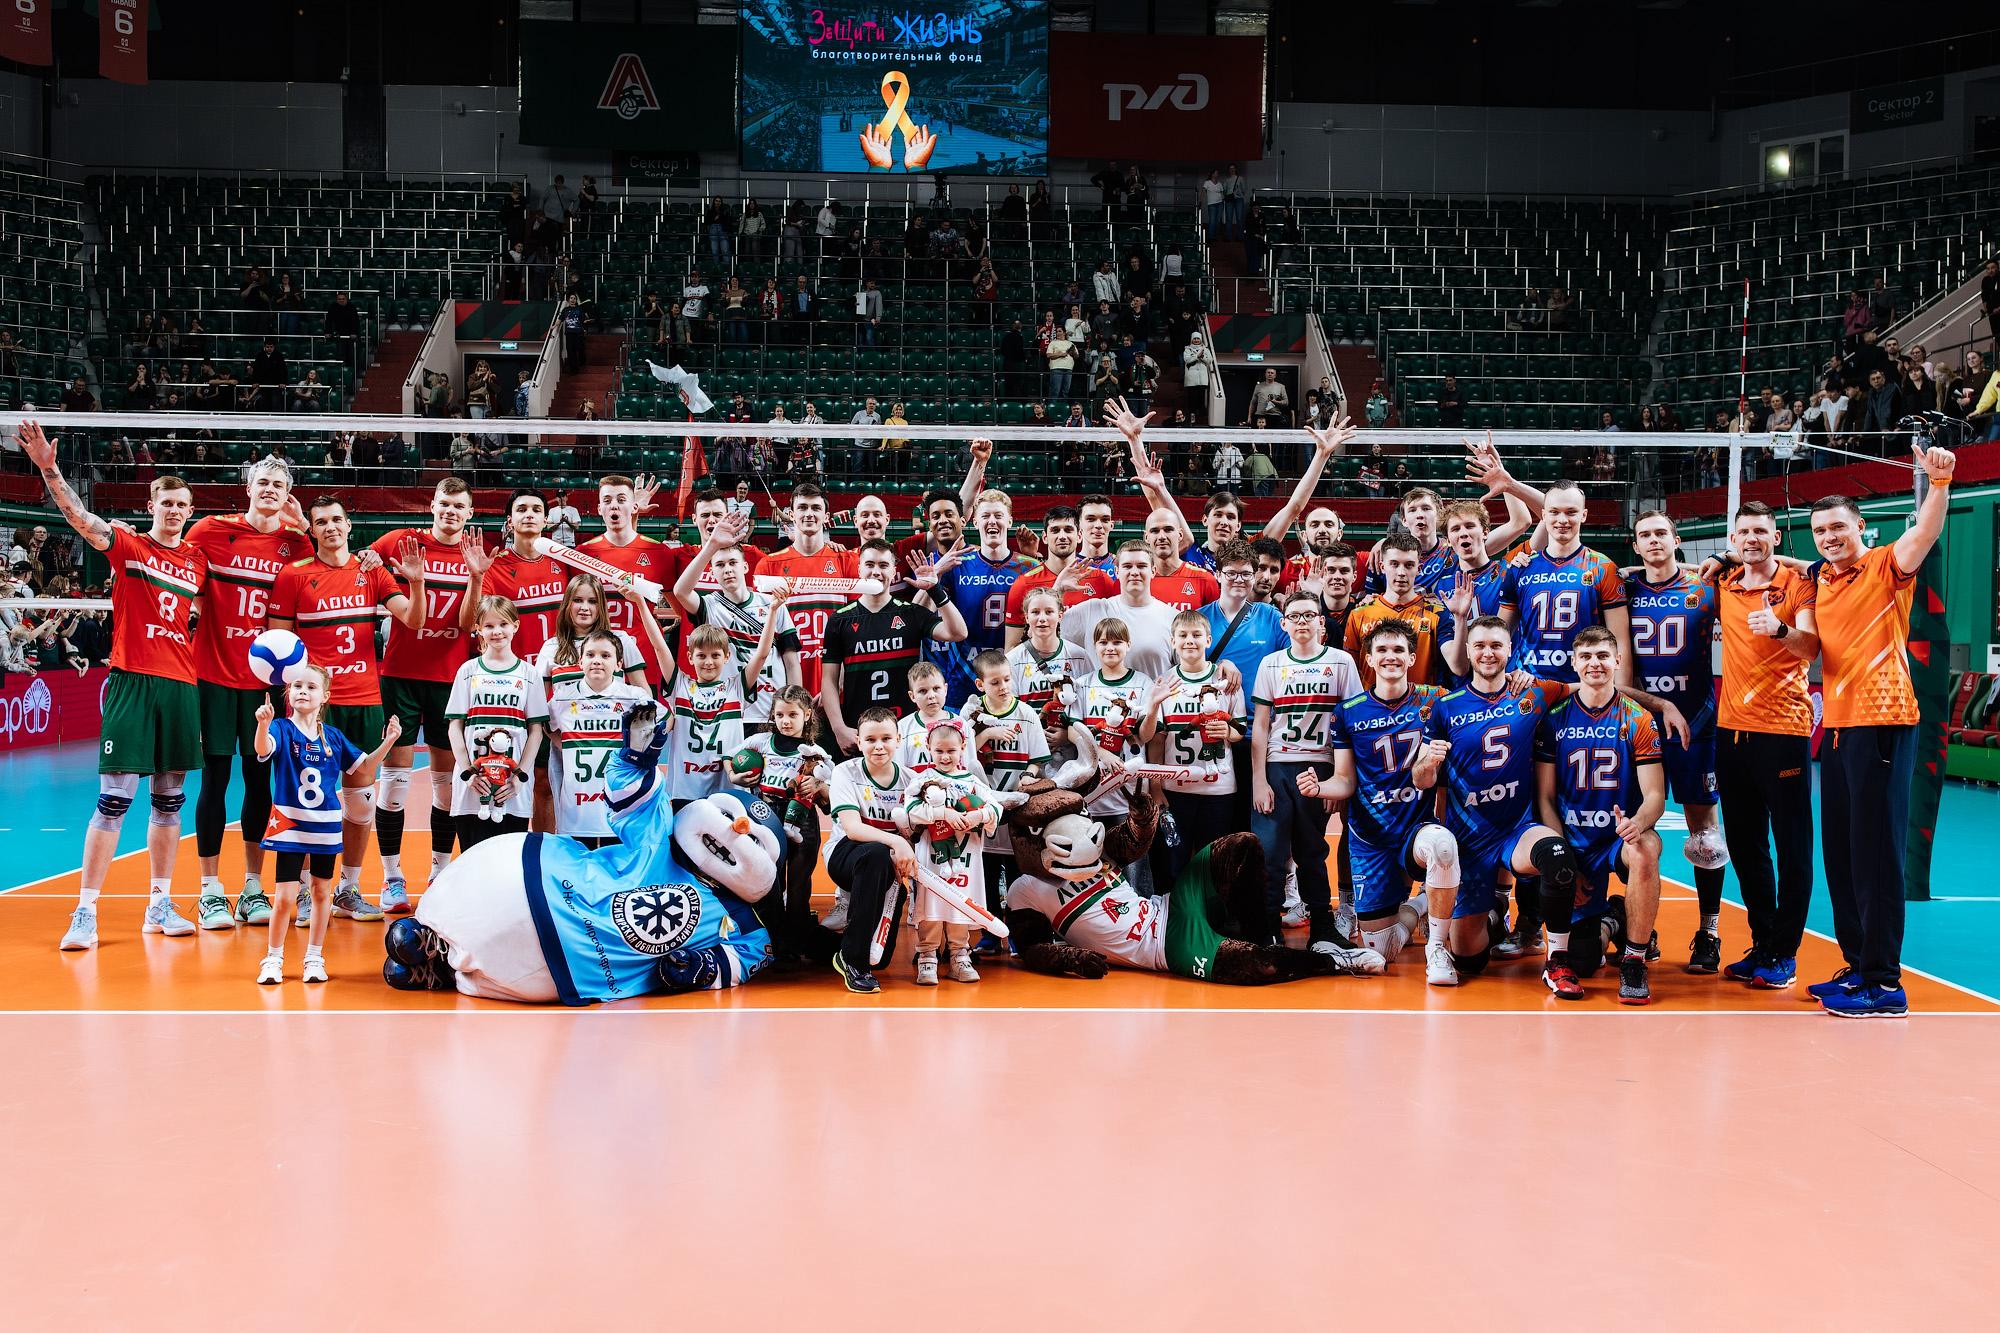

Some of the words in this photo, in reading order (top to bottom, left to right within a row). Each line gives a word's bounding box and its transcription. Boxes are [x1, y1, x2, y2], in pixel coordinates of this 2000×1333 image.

[114, 8, 134, 35] 6
[812, 49, 942, 62] благотворительный
[949, 52, 982, 63] фонд
[1868, 95, 1921, 113] Сектор
[1925, 90, 1935, 104] 2
[630, 156, 679, 172] Сектор
[959, 574, 1015, 587] КУЗБАСС
[1518, 572, 1577, 587] КУЗБАСС
[158, 591, 178, 623] 8
[237, 587, 269, 619] 16
[426, 590, 458, 619] 17
[608, 601, 634, 629] 21
[984, 593, 1007, 629] 8
[1532, 590, 1580, 630] 18
[538, 613, 548, 641] 1
[794, 611, 829, 639] 20
[1631, 616, 1687, 656] 20
[335, 626, 355, 654] 3
[870, 670, 890, 701] 2
[1282, 713, 1324, 745] 54
[1354, 712, 1415, 731] КУЗБАСС
[1450, 704, 1515, 727] КУЗБАСС
[104, 740, 113, 754] 8
[688, 720, 722, 755] 54
[1482, 724, 1511, 770] 5
[1555, 726, 1616, 742] КУЗБАСС
[305, 754, 319, 762] CUB
[1374, 728, 1423, 773] 17
[1568, 747, 1619, 790] 12
[298, 767, 324, 809] 8
[1464, 780, 1519, 808] АЗОТ
[635, 941, 670, 954] ОБЛАСТЬ
[1193, 956, 1208, 978] 54
